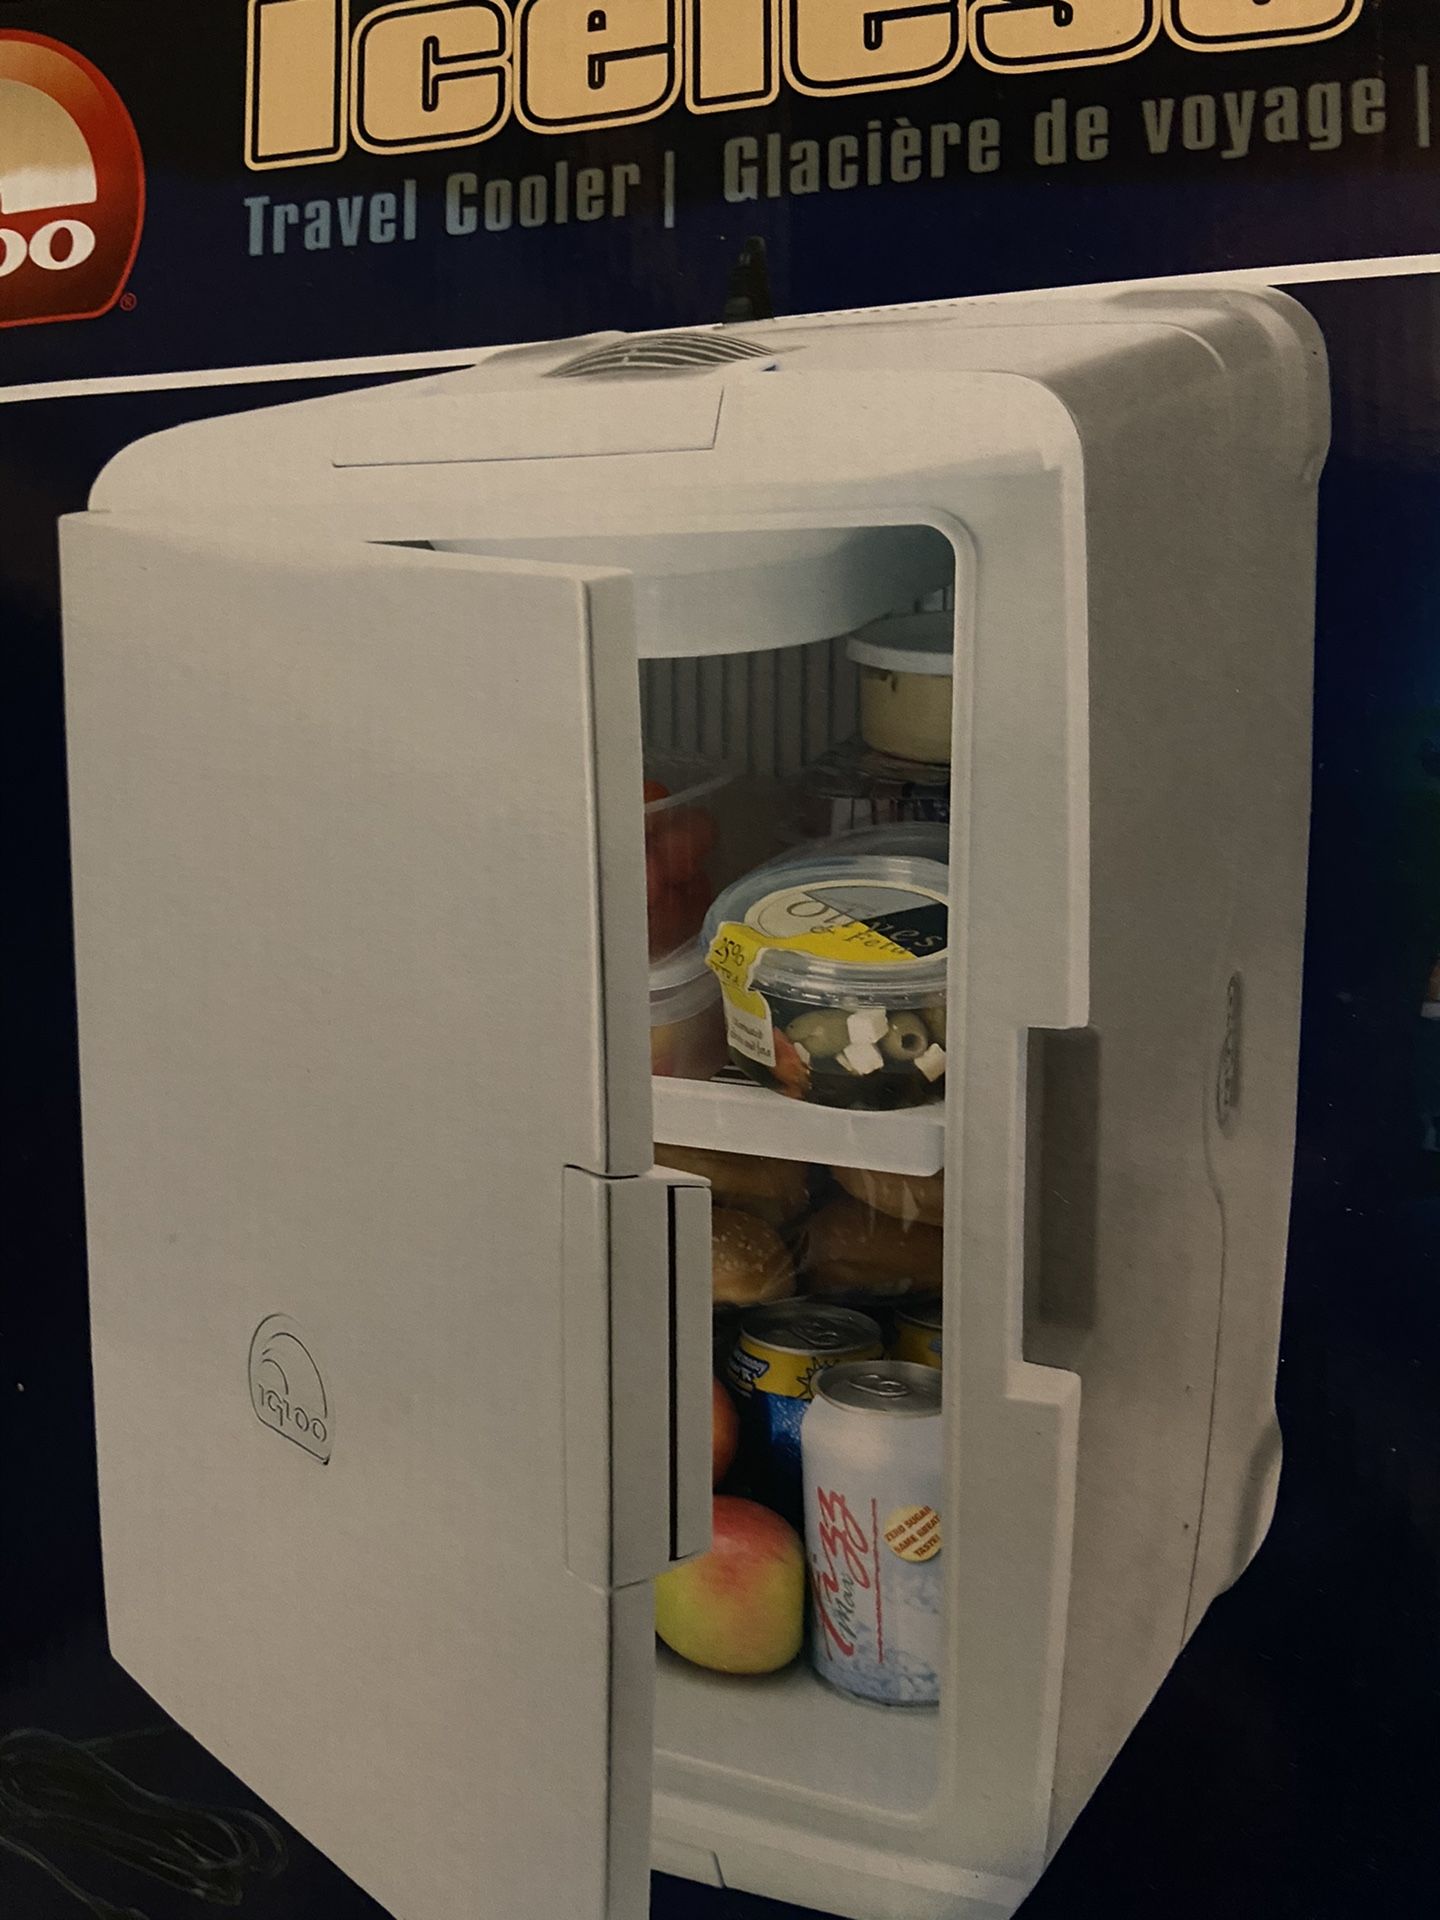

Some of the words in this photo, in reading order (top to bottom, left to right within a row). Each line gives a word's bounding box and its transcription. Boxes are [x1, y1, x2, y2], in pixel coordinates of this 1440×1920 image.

[244, 179, 417, 257] Travel
[445, 160, 641, 237] Cooler
[724, 117, 1000, 203] Glacière
[1034, 98, 1109, 166] de
[1143, 76, 1387, 160] voyage
